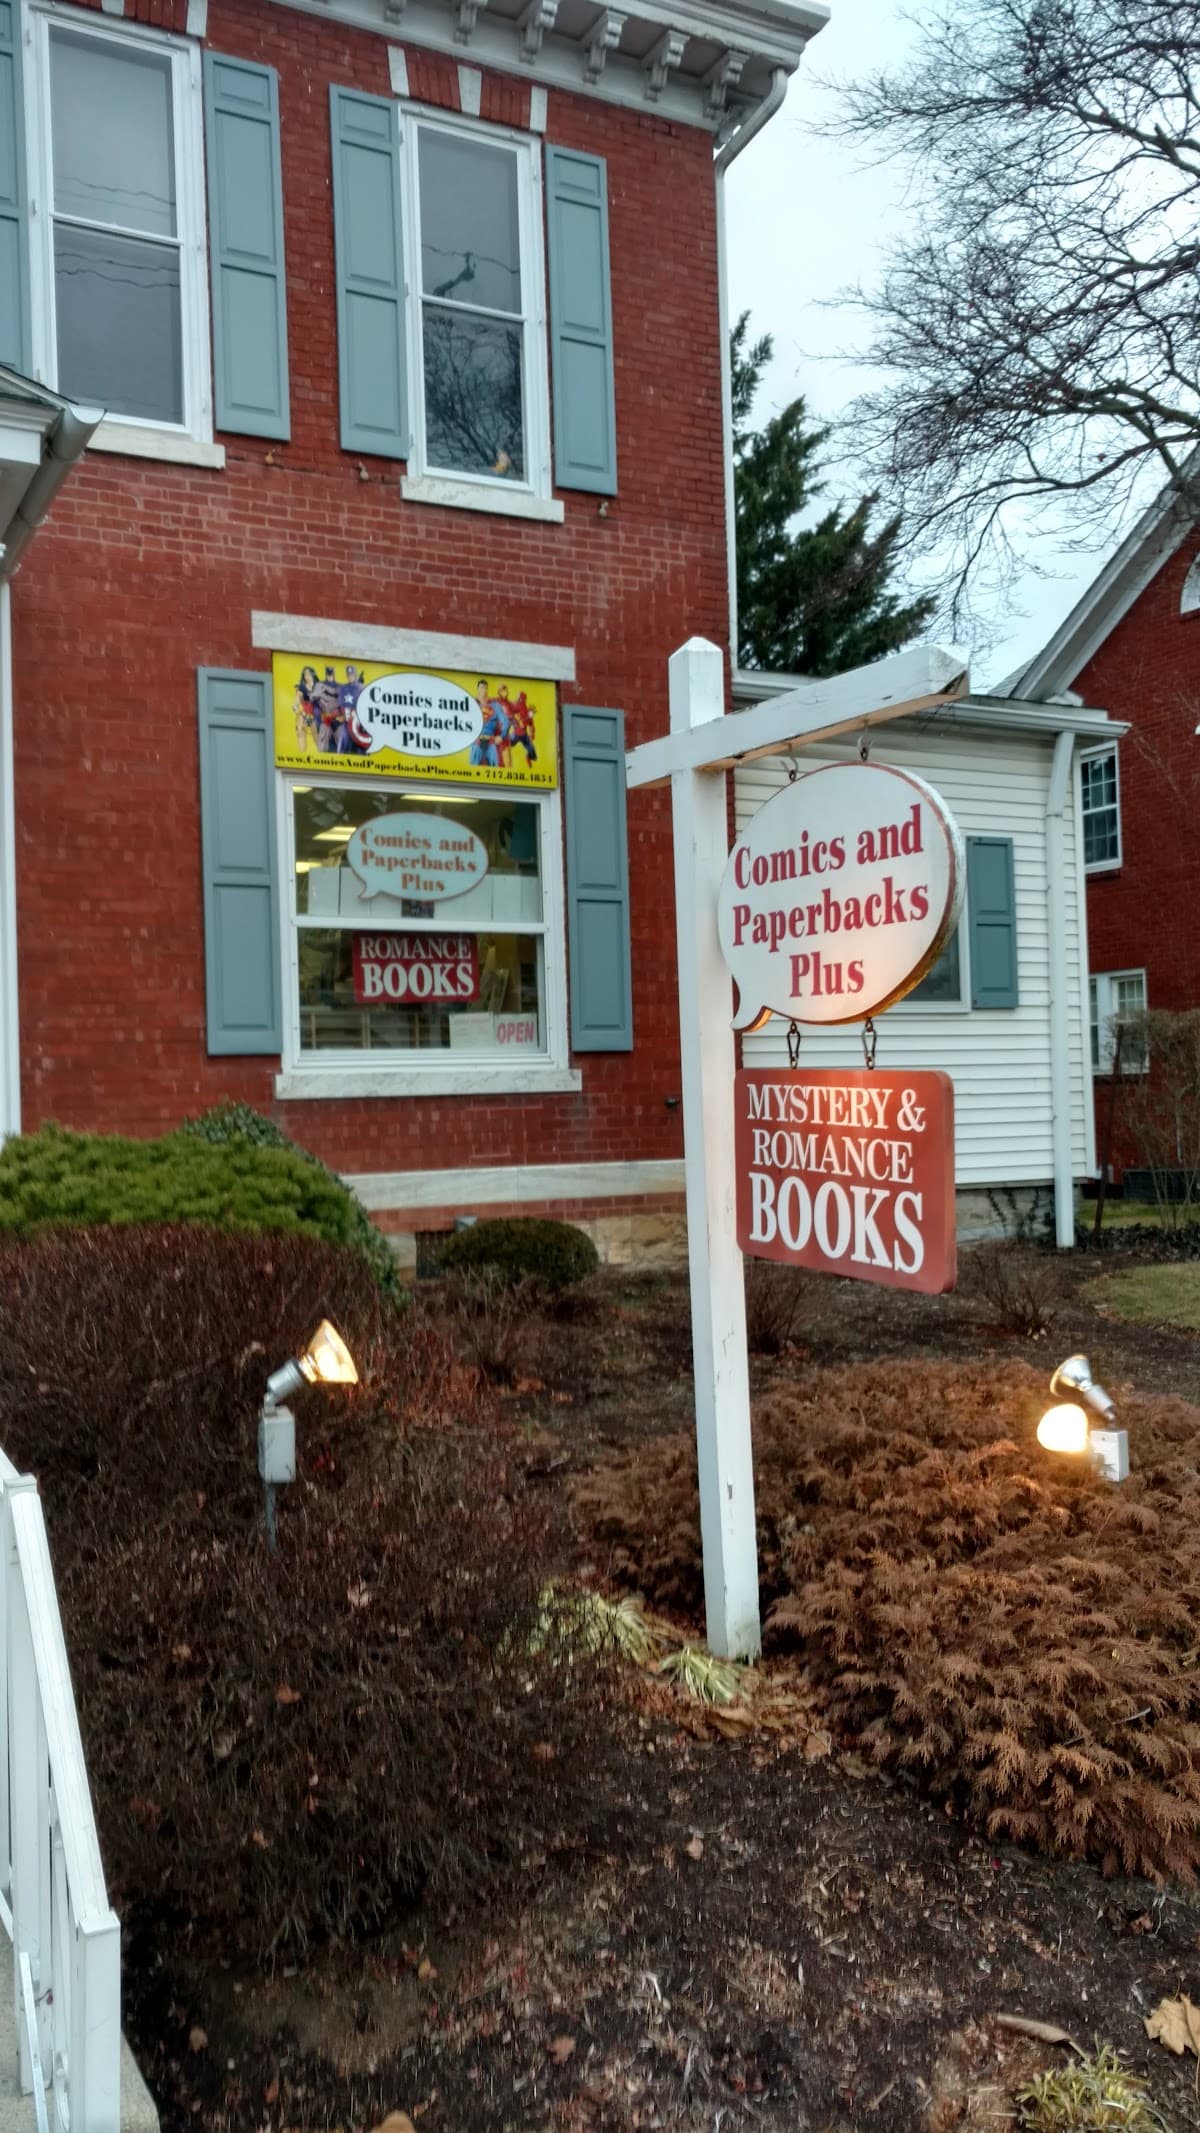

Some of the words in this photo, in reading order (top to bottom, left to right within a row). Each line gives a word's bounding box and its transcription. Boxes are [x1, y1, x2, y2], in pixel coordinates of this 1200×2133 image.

[369, 686, 433, 710] Comics
[438, 694, 470, 712] and
[367, 707, 473, 732] Paperbacks
[402, 731, 442, 750] Plus
[277, 755, 473, 777] www.ComicsAndPaperbacksPlus.com
[360, 828, 431, 849] Comics
[439, 836, 475, 853] and
[735, 829, 846, 890] Comics
[856, 803, 924, 865] and
[361, 849, 476, 872] Paperbacks
[401, 873, 445, 892] Plus
[732, 876, 929, 953] Paperbacks
[359, 936, 472, 960] ROMANCE
[361, 962, 475, 997] BOOKS
[789, 951, 865, 998] Plus
[496, 1021, 534, 1045] OPEN
[746, 1083, 894, 1130] MYSTERY
[896, 1088, 926, 1133] &
[752, 1128, 914, 1184] ROMANCE
[748, 1172, 925, 1274] BOOKS
